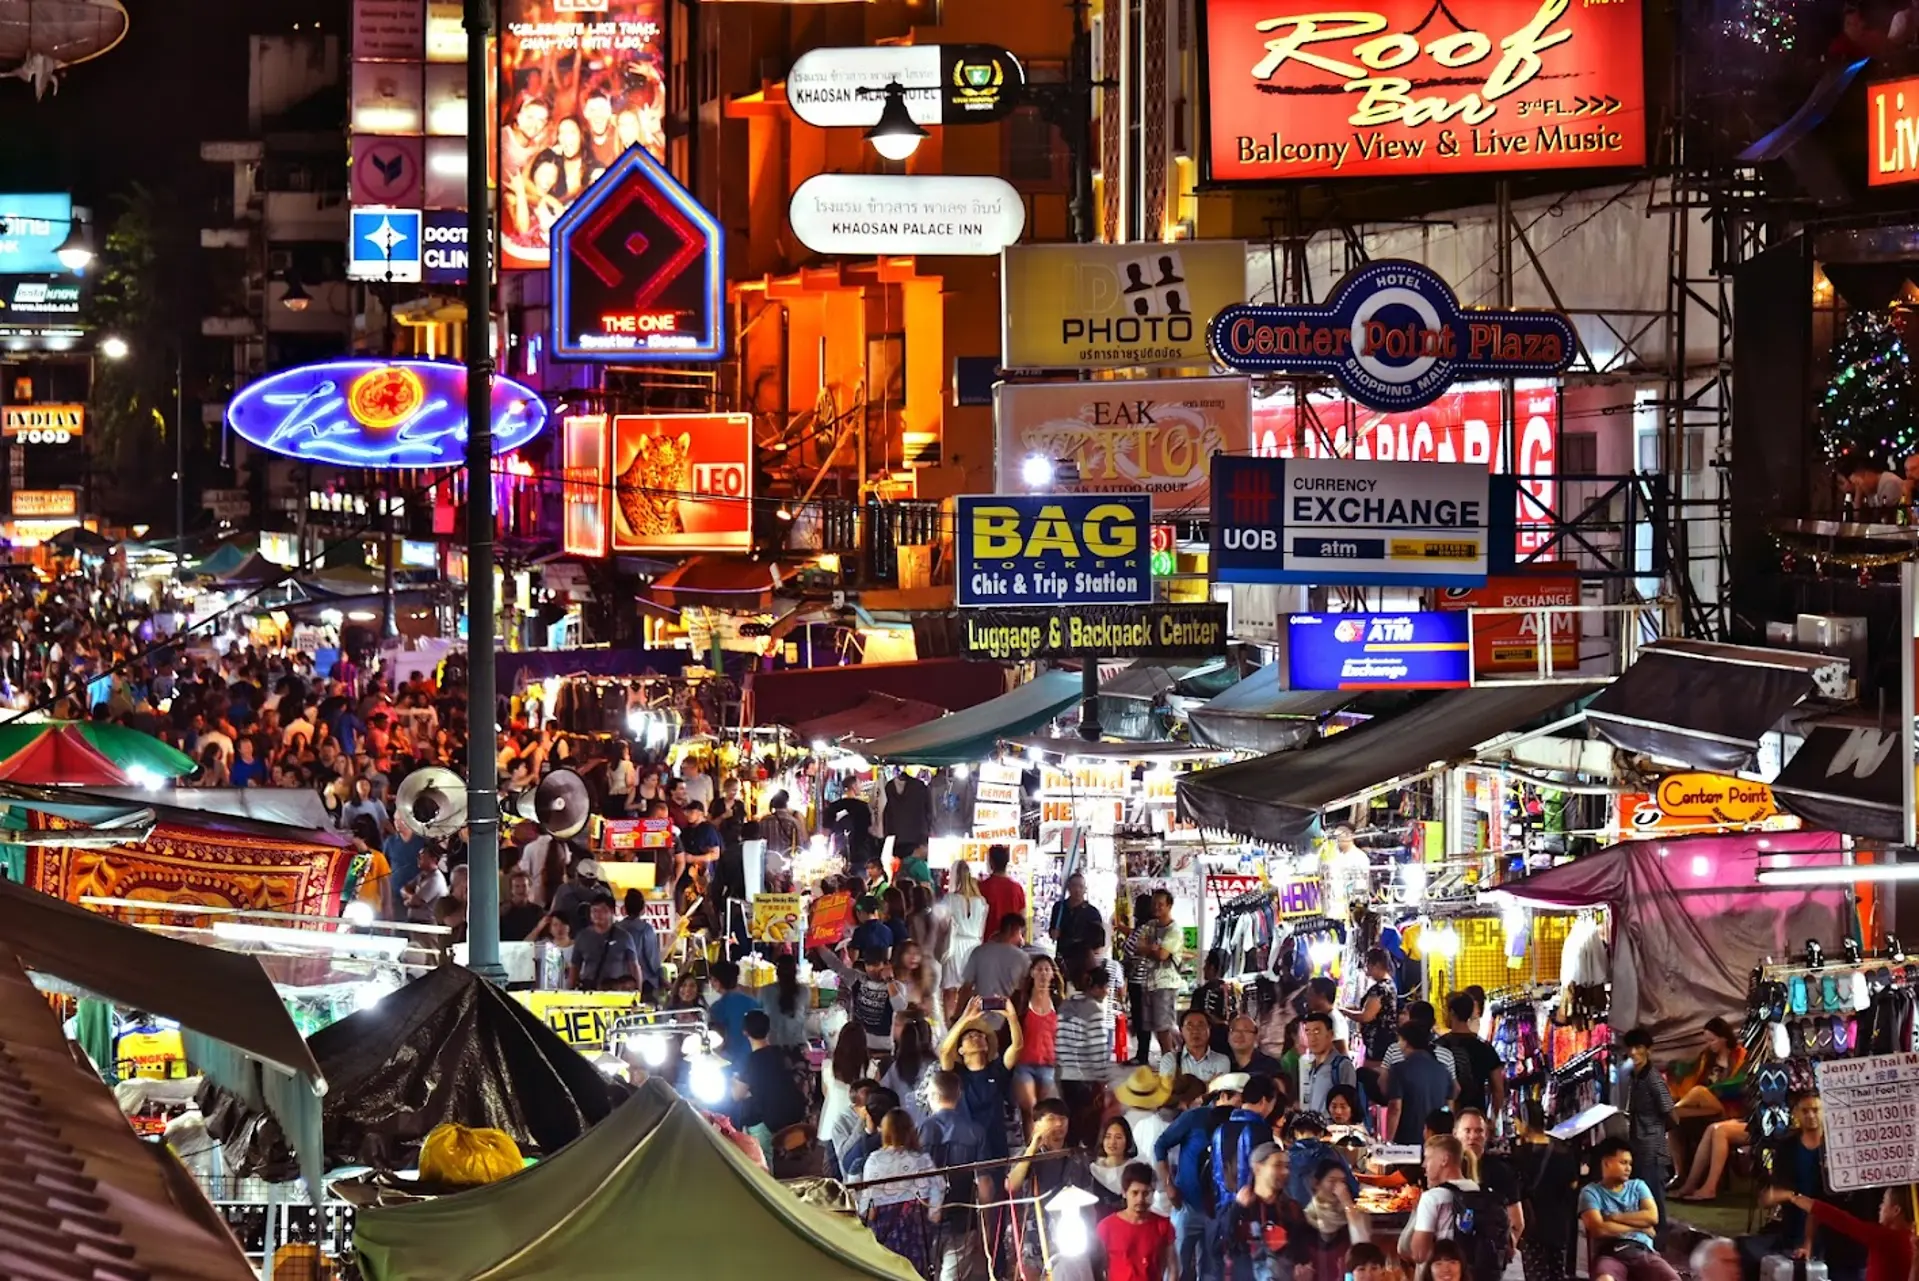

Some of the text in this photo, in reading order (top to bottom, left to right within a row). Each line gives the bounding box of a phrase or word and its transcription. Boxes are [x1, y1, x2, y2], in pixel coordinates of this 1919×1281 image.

[1250, 0, 1573, 101] Roof
[796, 87, 851, 105] KHAOSAN
[1343, 76, 1497, 128] Bar
[1236, 124, 1623, 170] Balcony View & Live Music
[814, 196, 862, 214] โรงแรม
[867, 196, 918, 214] ข้าวสาร
[832, 222, 983, 236] KHAOSAN PALACE INN
[1376, 274, 1422, 291] HOTEL
[602, 314, 675, 332] THE ONE
[1062, 317, 1193, 344] PHOTO
[1230, 317, 1563, 362] Center Point Plaza
[1345, 358, 1452, 396] SHOPPING MALL
[7, 410, 81, 428] INDIAN
[262, 380, 361, 446] The
[1093, 401, 1156, 425] EAK
[16, 429, 71, 444] FOOD
[698, 467, 743, 495] LEO
[1094, 484, 1142, 493] TATTOO
[1293, 477, 1378, 493] CURRENCY
[1293, 496, 1481, 527] EXCHANGE
[972, 503, 1138, 559] BAG
[1223, 528, 1278, 551] UOB
[1320, 539, 1358, 558] atm
[973, 559, 1137, 570] LOCKER
[971, 570, 1138, 598] Chic & Trip Station
[1503, 595, 1573, 607] EXCHANGE
[968, 615, 1219, 658] Luggage & Backpack Center
[1366, 623, 1414, 642] ATM
[1340, 663, 1408, 680] Exchange
[1663, 780, 1768, 808] Center Point
[975, 825, 1017, 840] HENNA
[1207, 879, 1263, 891] SIAM
[1822, 1061, 1866, 1074] Jenny
[1871, 1056, 1901, 1067] Thai
[1850, 1088, 1871, 1098] Thai
[1875, 1085, 1896, 1095] Foot
[1852, 1109, 1874, 1122] 130
[1877, 1106, 1899, 1119] 130
[1855, 1128, 1877, 1142] 230
[1880, 1125, 1902, 1140] 230
[1857, 1149, 1879, 1162] 350
[1882, 1145, 1904, 1159] 350
[1842, 1170, 1850, 1184] 2
[1860, 1168, 1882, 1181] 450
[1885, 1164, 1906, 1178] 450
